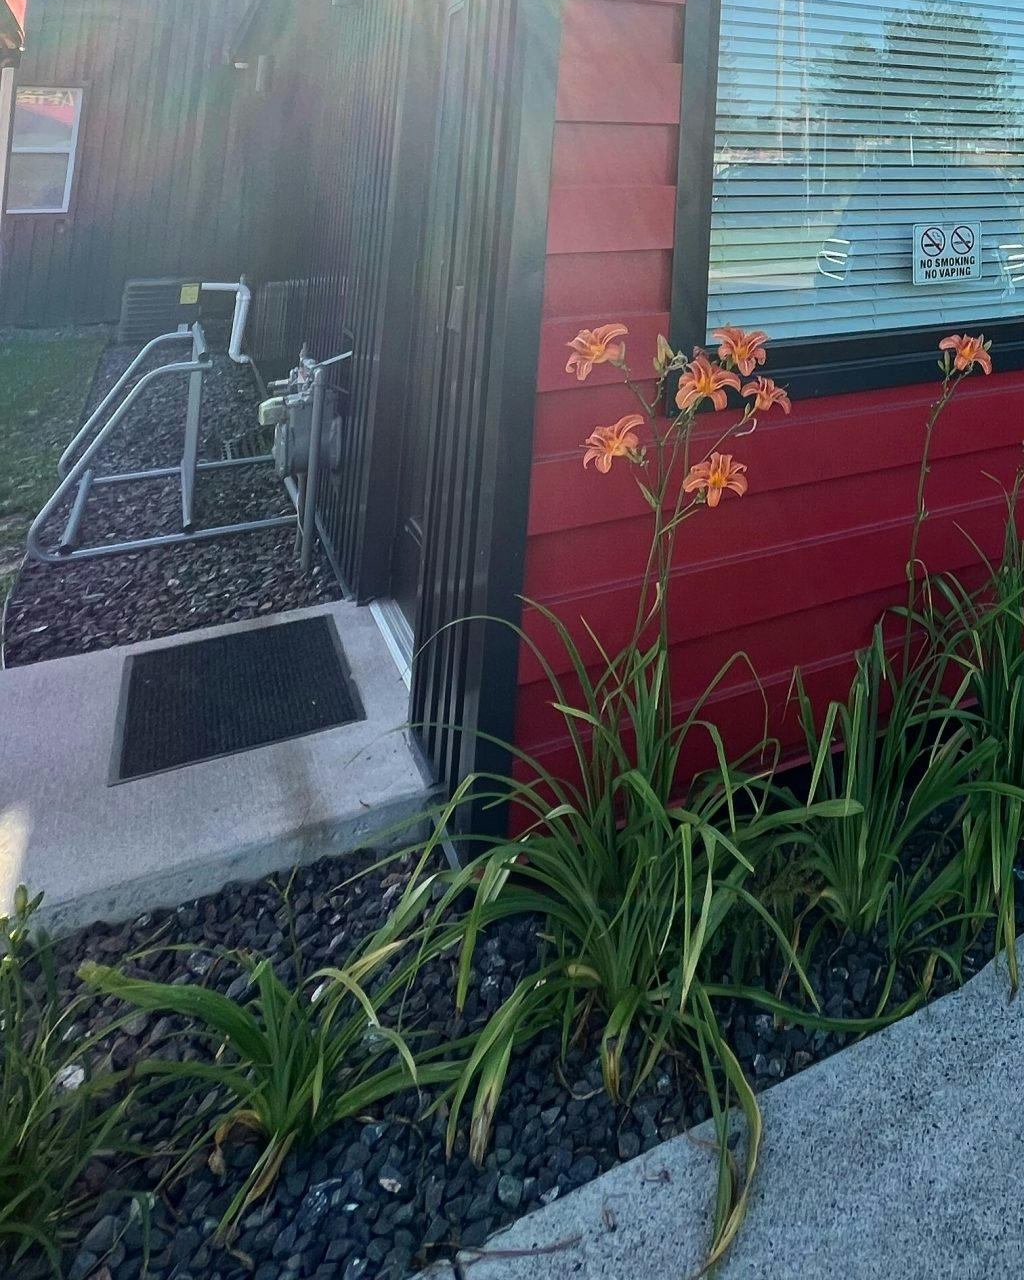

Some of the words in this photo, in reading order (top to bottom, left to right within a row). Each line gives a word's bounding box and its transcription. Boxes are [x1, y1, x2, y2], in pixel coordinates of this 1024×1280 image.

[920, 259, 933, 269] NO
[935, 256, 975, 268] SMOKING
[924, 269, 937, 279] NO
[939, 267, 971, 278] VAPING
